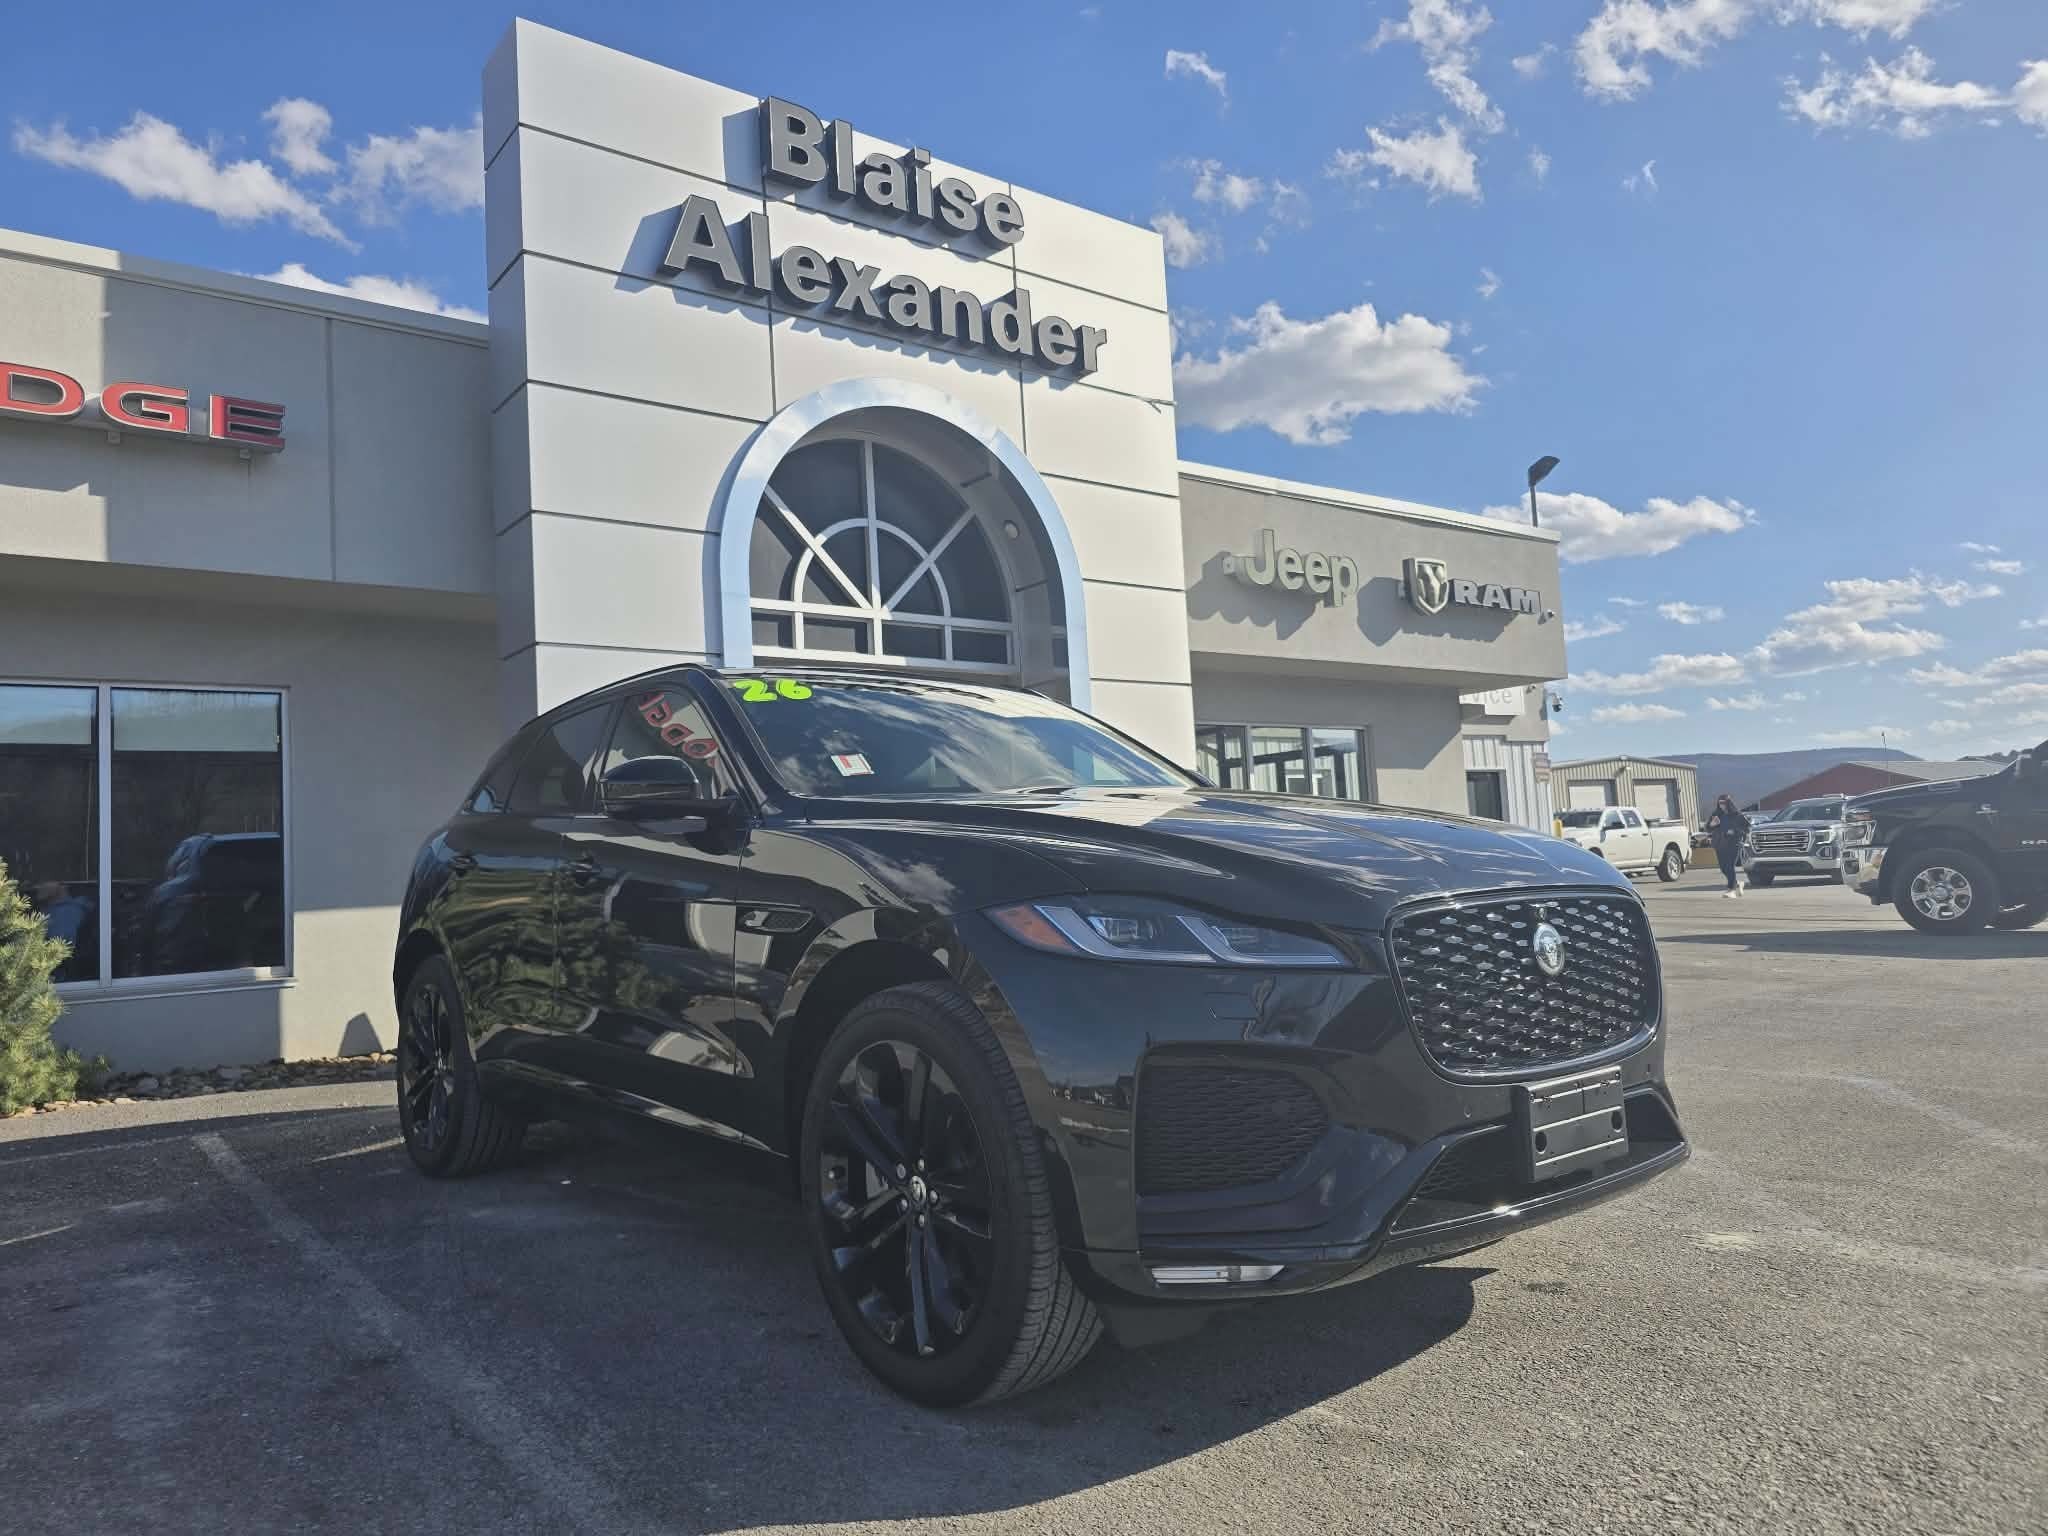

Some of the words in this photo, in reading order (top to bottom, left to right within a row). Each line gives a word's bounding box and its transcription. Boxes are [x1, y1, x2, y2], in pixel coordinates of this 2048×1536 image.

[764, 96, 1025, 246] Blaise
[663, 194, 1108, 374] Alexander
[1244, 528, 1359, 608] Jeep
[1450, 578, 1542, 614] RAM
[734, 678, 813, 701] 26
